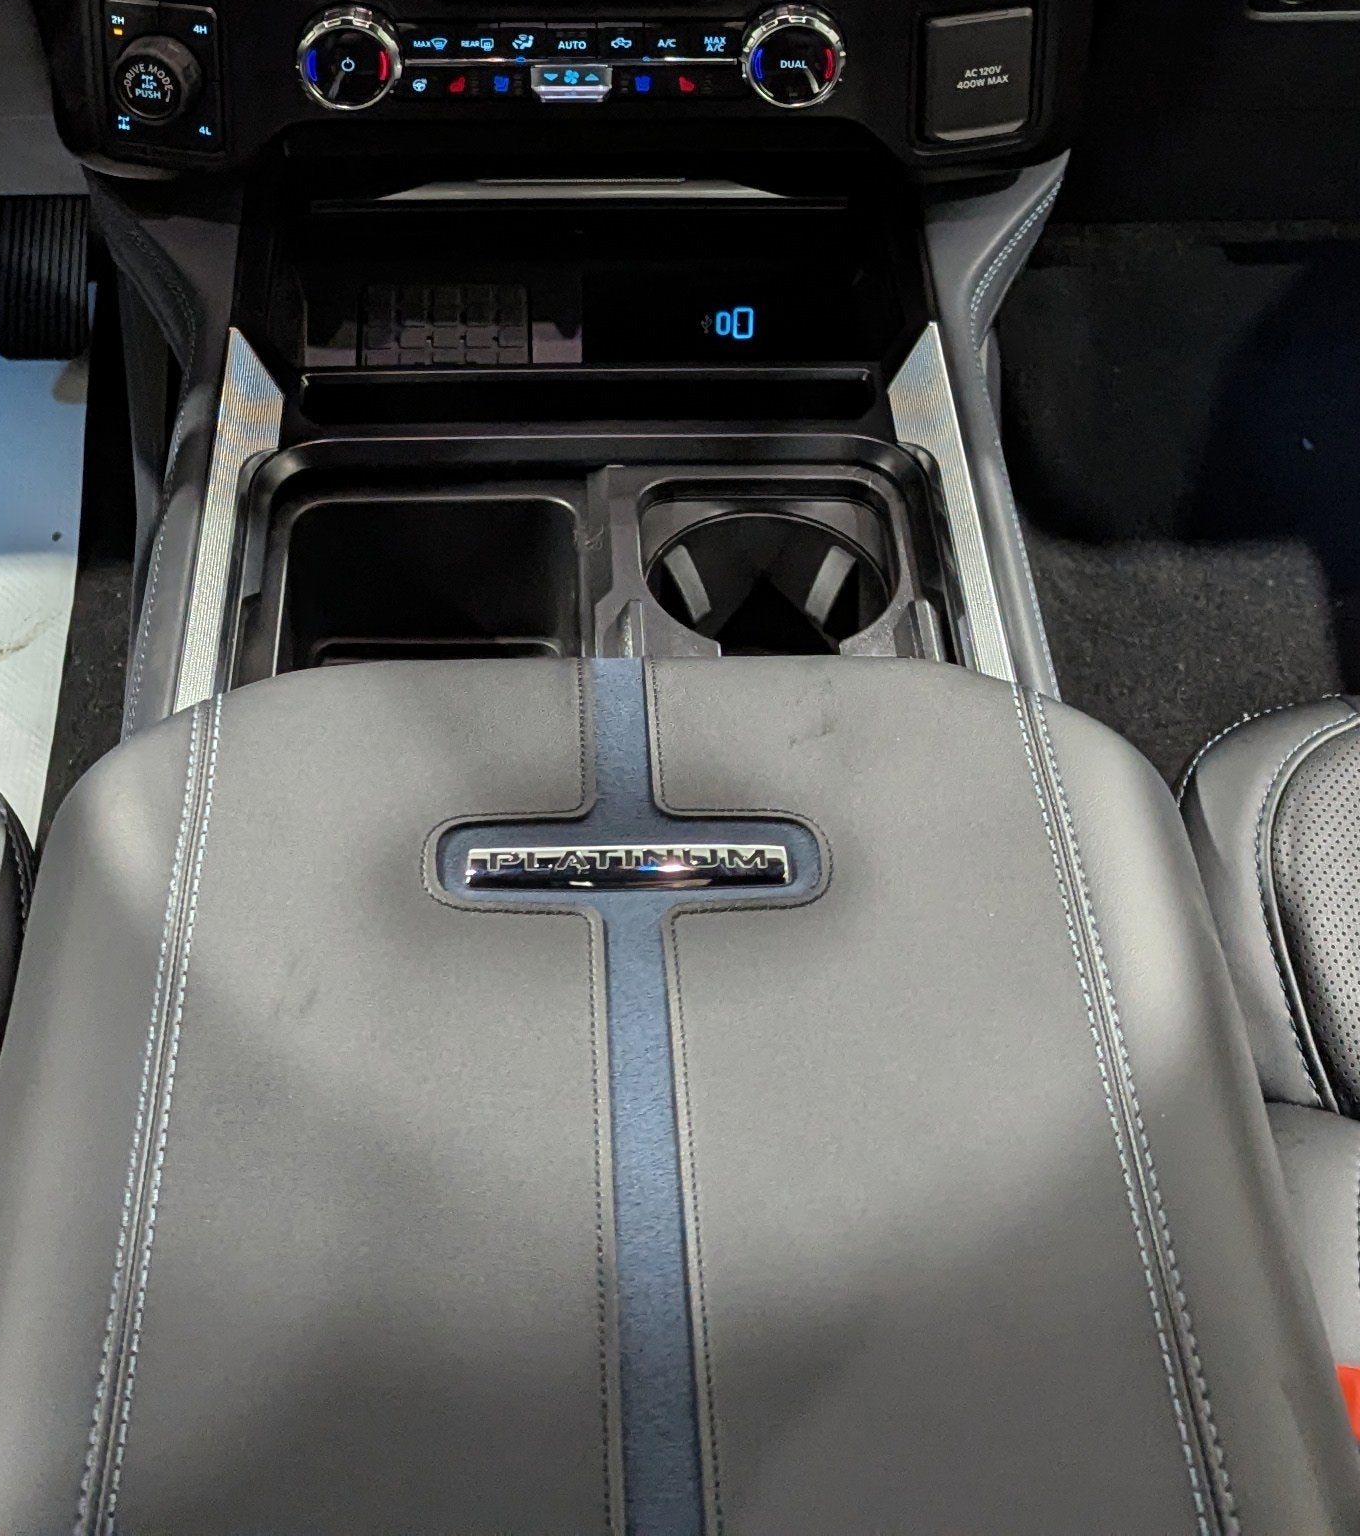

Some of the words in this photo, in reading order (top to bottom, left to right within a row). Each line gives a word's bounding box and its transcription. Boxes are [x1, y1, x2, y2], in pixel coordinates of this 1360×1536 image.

[111, 15, 125, 25] 2H
[193, 24, 207, 34] 4H
[413, 40, 431, 48] MAX
[460, 40, 480, 48] REAR
[558, 40, 587, 50] AUTO
[658, 38, 677, 49] A/C
[704, 36, 727, 45] MAX
[706, 43, 725, 53] A/C
[780, 59, 808, 70] DUAL
[964, 68, 977, 78] AC
[979, 65, 1002, 76] 120V
[124, 63, 146, 87] DRIVE
[147, 64, 174, 91] MODE
[956, 77, 985, 90] 400W
[987, 74, 1009, 85] MAX
[135, 88, 161, 99] PUSH
[199, 126, 212, 136] 4L
[487, 848, 769, 872] PLATINUM
